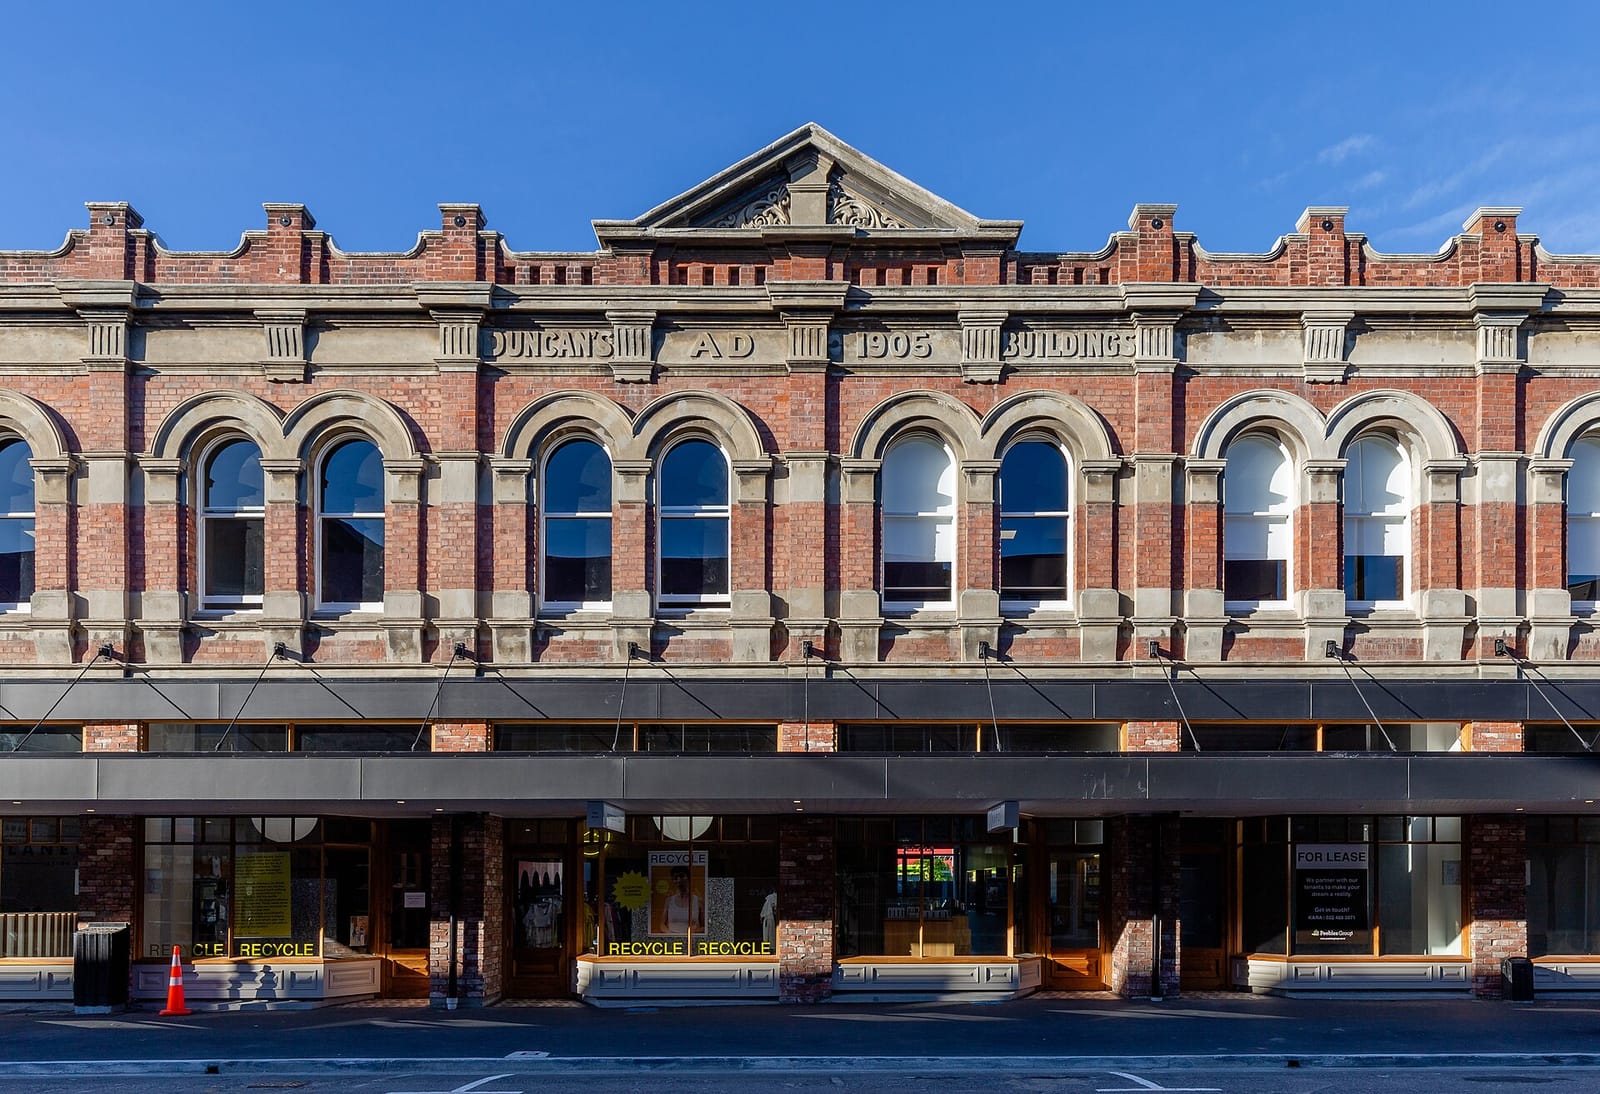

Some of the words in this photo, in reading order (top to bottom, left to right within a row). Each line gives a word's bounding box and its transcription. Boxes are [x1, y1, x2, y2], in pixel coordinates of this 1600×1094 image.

[492, 330, 614, 358] DUNCAN'S
[856, 331, 933, 358] 1905
[1002, 330, 1137, 358] BUILDINGS
[650, 854, 706, 864] RECYCLE
[1297, 851, 1323, 862] FOR
[1326, 851, 1366, 862] LEASE
[149, 943, 224, 957] REYCLE
[239, 942, 314, 957] RECYCLE
[609, 941, 683, 956] RECYCLE
[697, 941, 772, 956] RECYCLE
